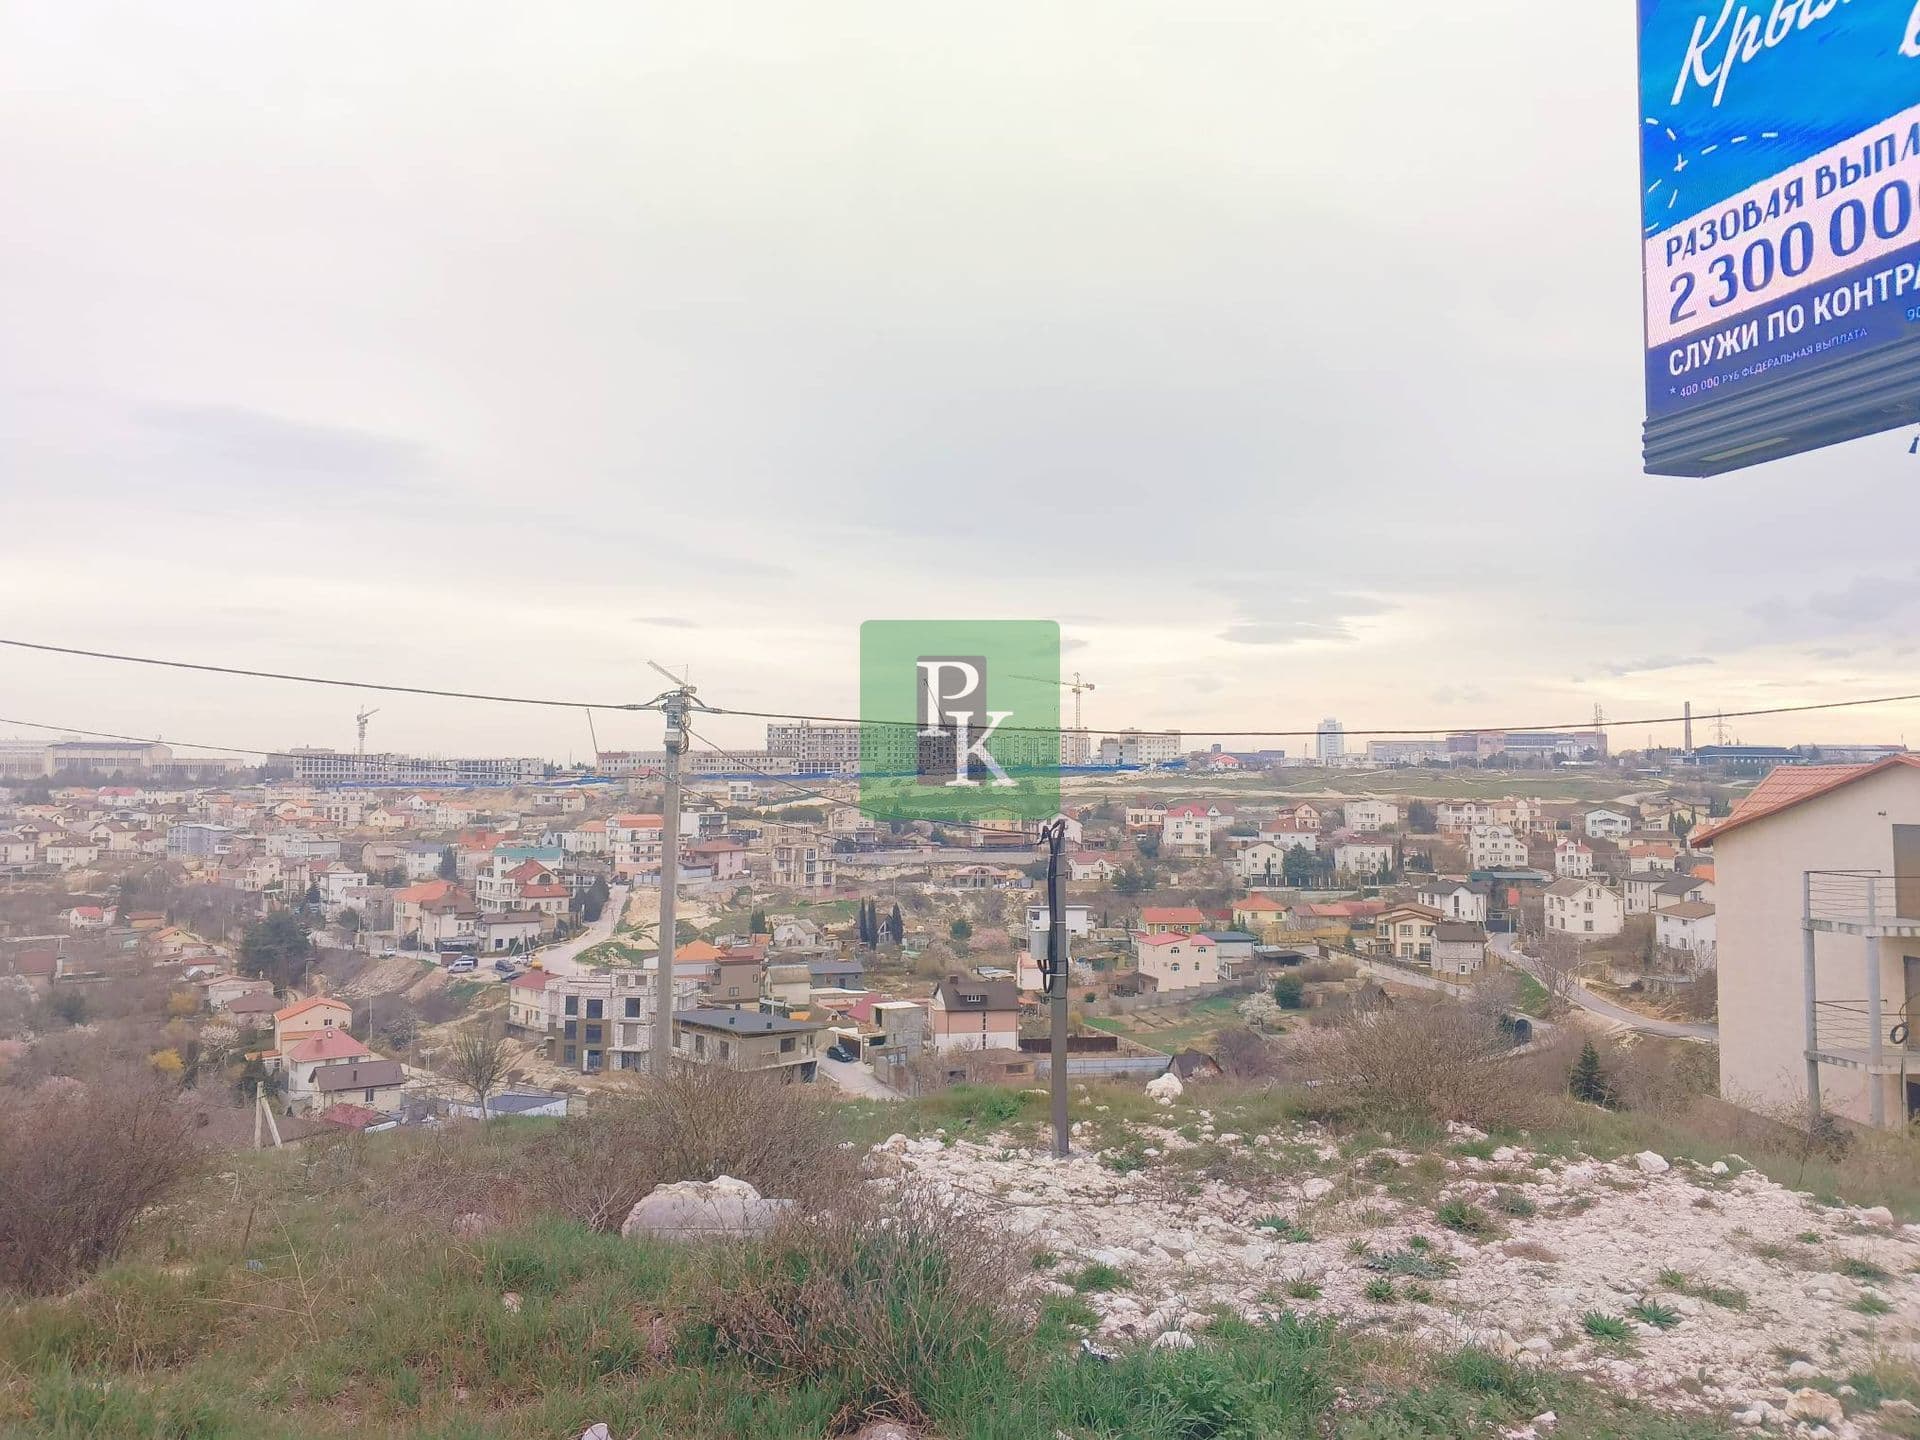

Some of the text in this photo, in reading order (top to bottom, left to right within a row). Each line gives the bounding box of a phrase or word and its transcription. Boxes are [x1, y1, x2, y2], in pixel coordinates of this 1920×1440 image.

[1666, 177, 1804, 267] РАЗОВАЯ
[1669, 179, 1920, 326] 2 300 00
[1669, 319, 1759, 376] СЛУЖИ
[1768, 304, 1804, 342] ПО
[1680, 383, 1699, 397] 400
[1701, 376, 1720, 390] 000
[1741, 344, 1814, 377] ФЕДЕРАЛЬНАЯ
[1815, 328, 1868, 352] ВЫПЛАТА
